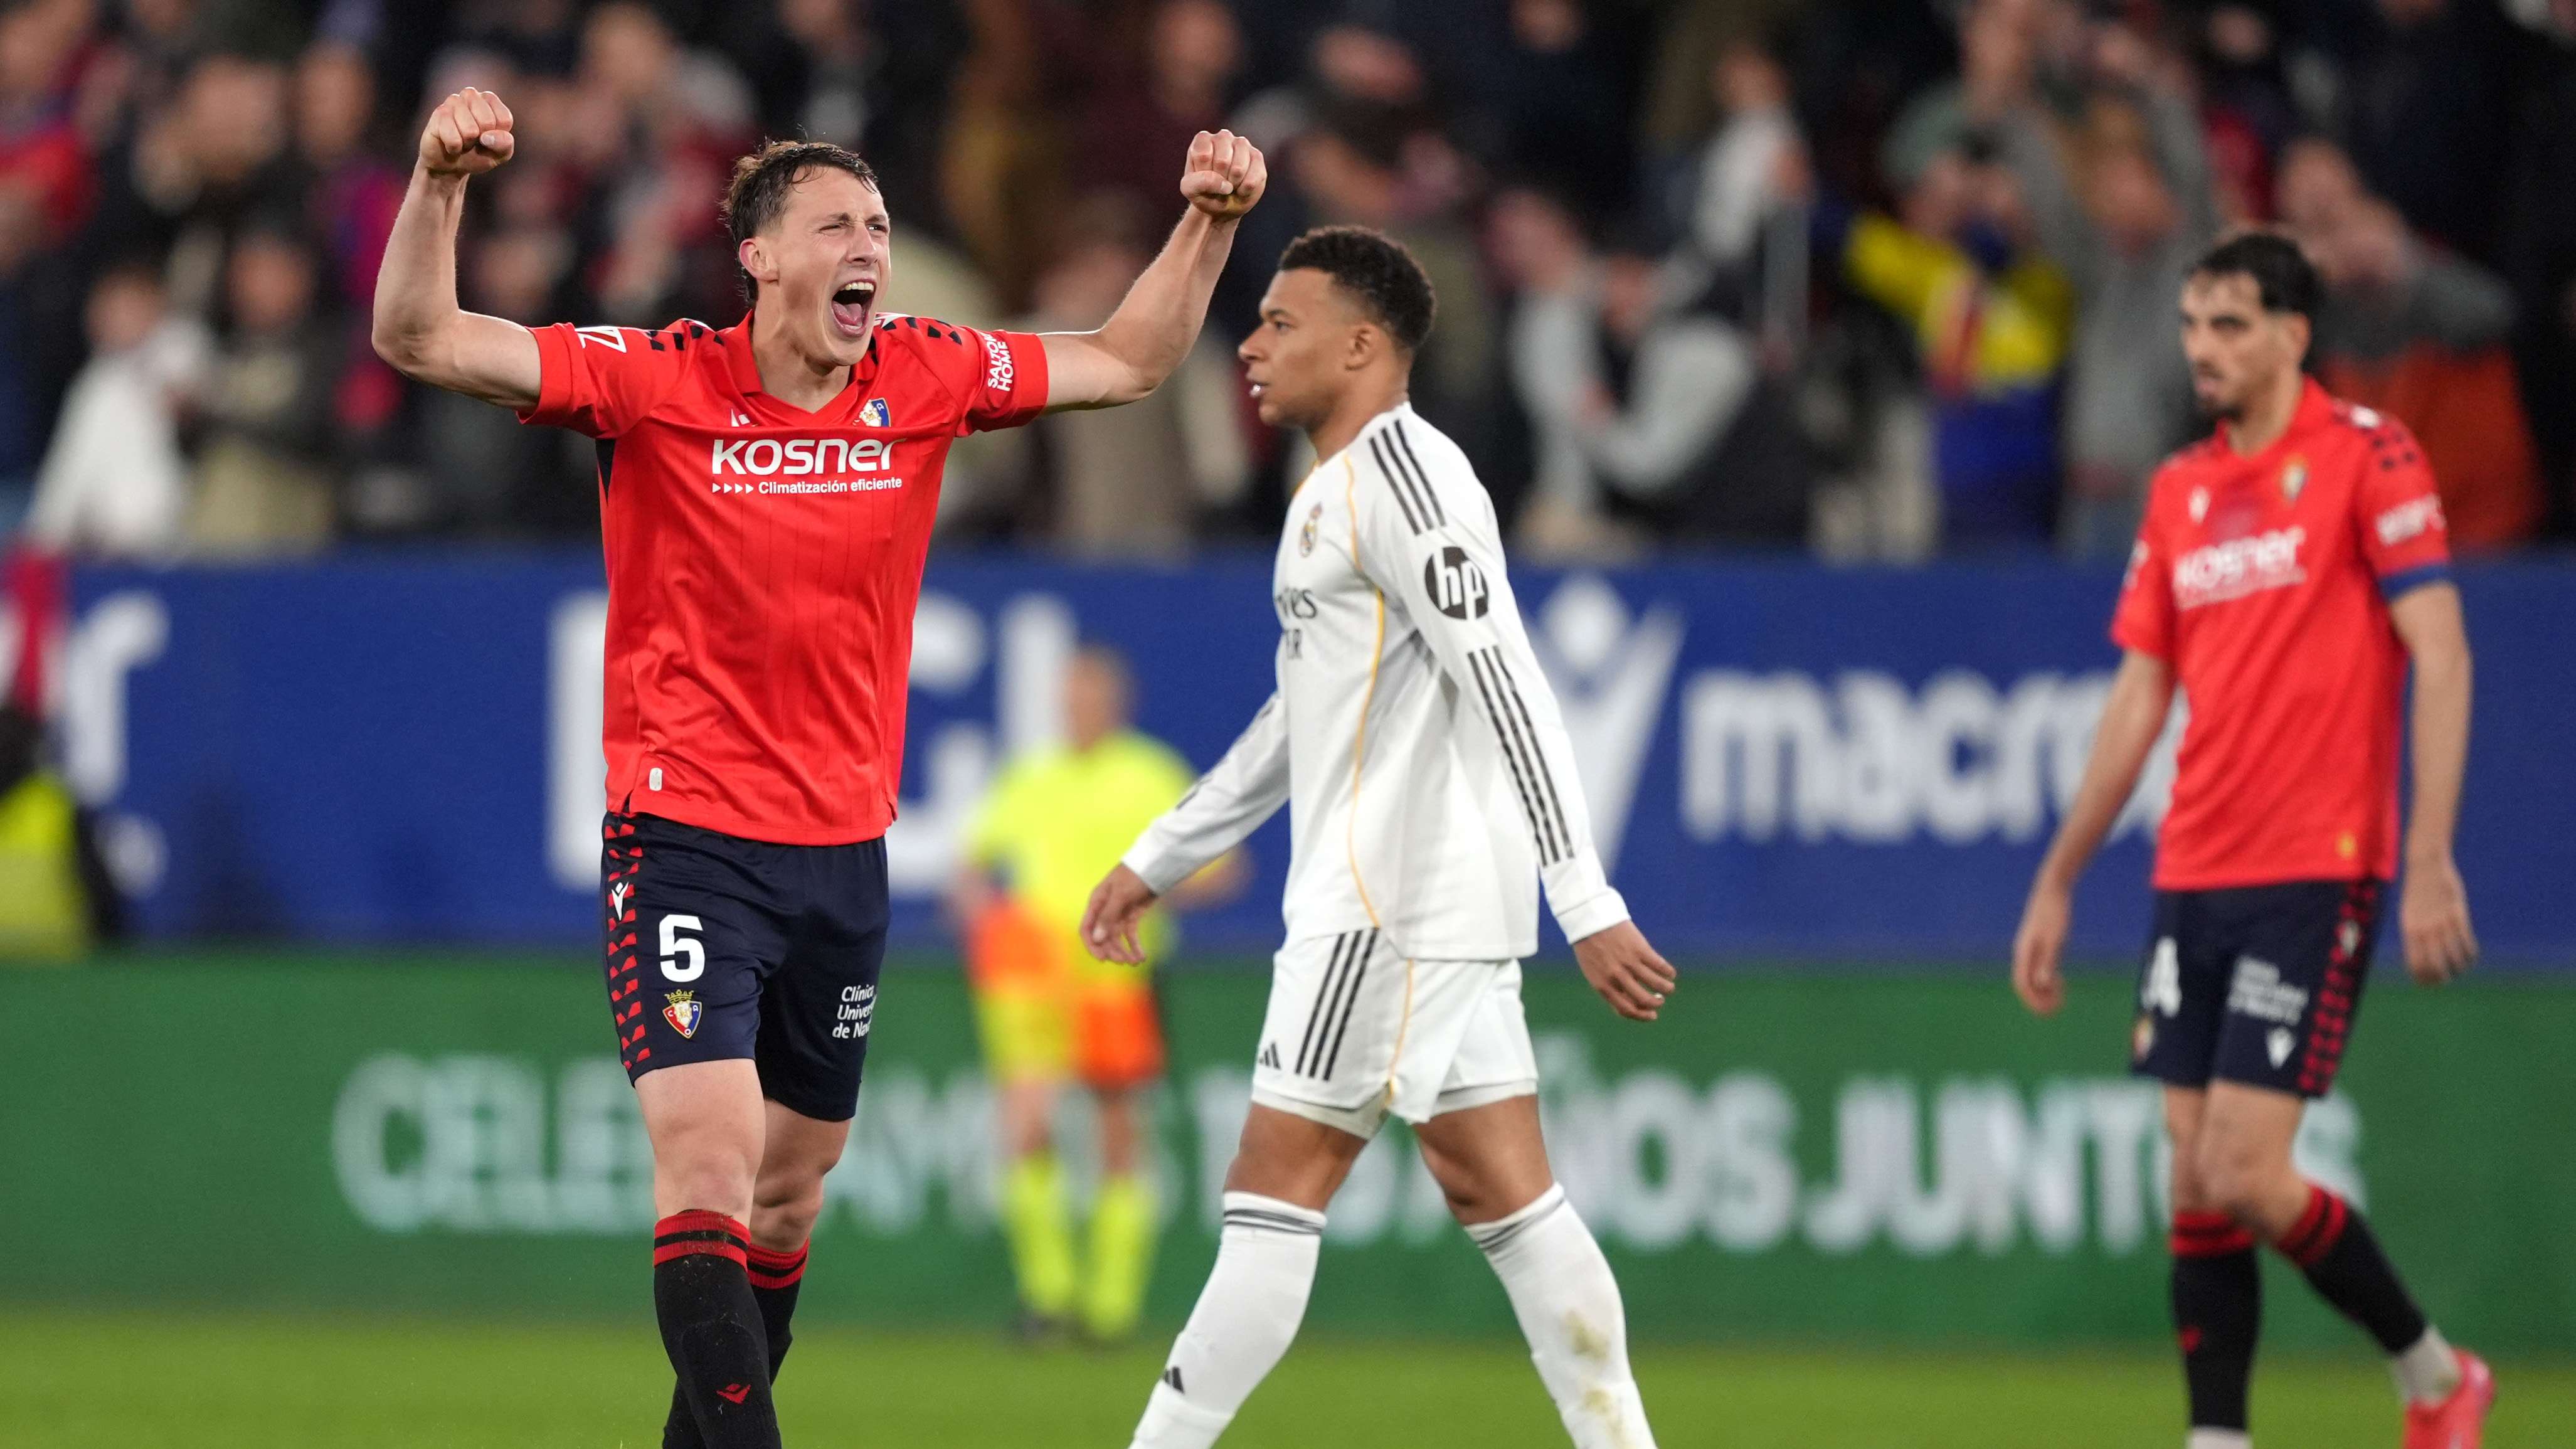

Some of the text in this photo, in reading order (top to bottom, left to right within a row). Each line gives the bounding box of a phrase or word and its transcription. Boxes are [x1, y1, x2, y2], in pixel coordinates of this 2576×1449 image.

[997, 341, 1014, 392] HOME
[758, 476, 903, 494] Climatización eficiente
[1429, 547, 1487, 620] hp
[659, 913, 706, 983] 5
[832, 1021, 850, 1039] de
